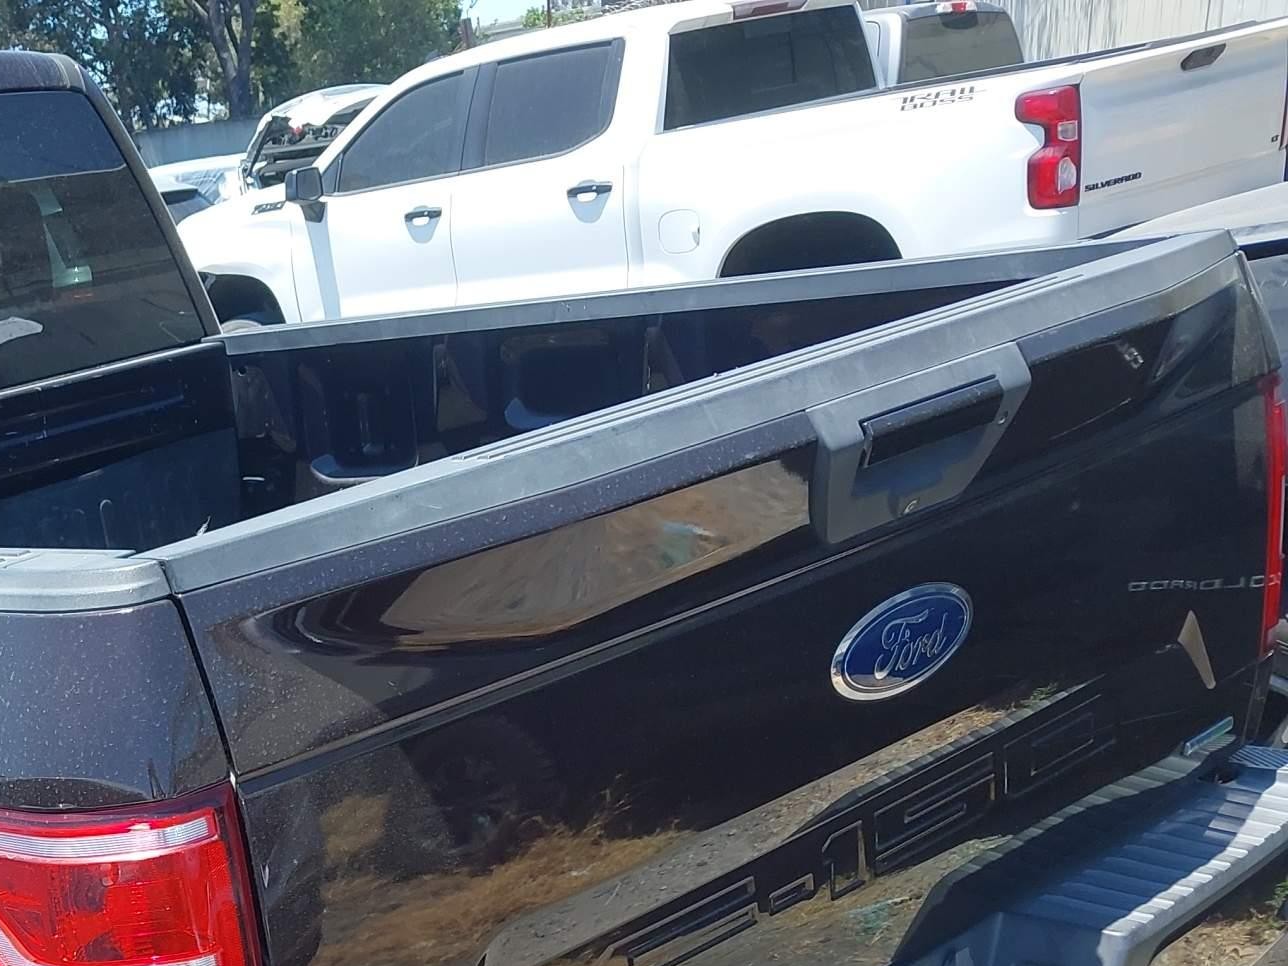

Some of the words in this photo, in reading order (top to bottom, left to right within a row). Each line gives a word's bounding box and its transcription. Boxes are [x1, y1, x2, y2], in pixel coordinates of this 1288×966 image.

[894, 86, 986, 105] TRAIL
[1084, 172, 1142, 193] SILVERADO
[874, 606, 946, 680] Ford
